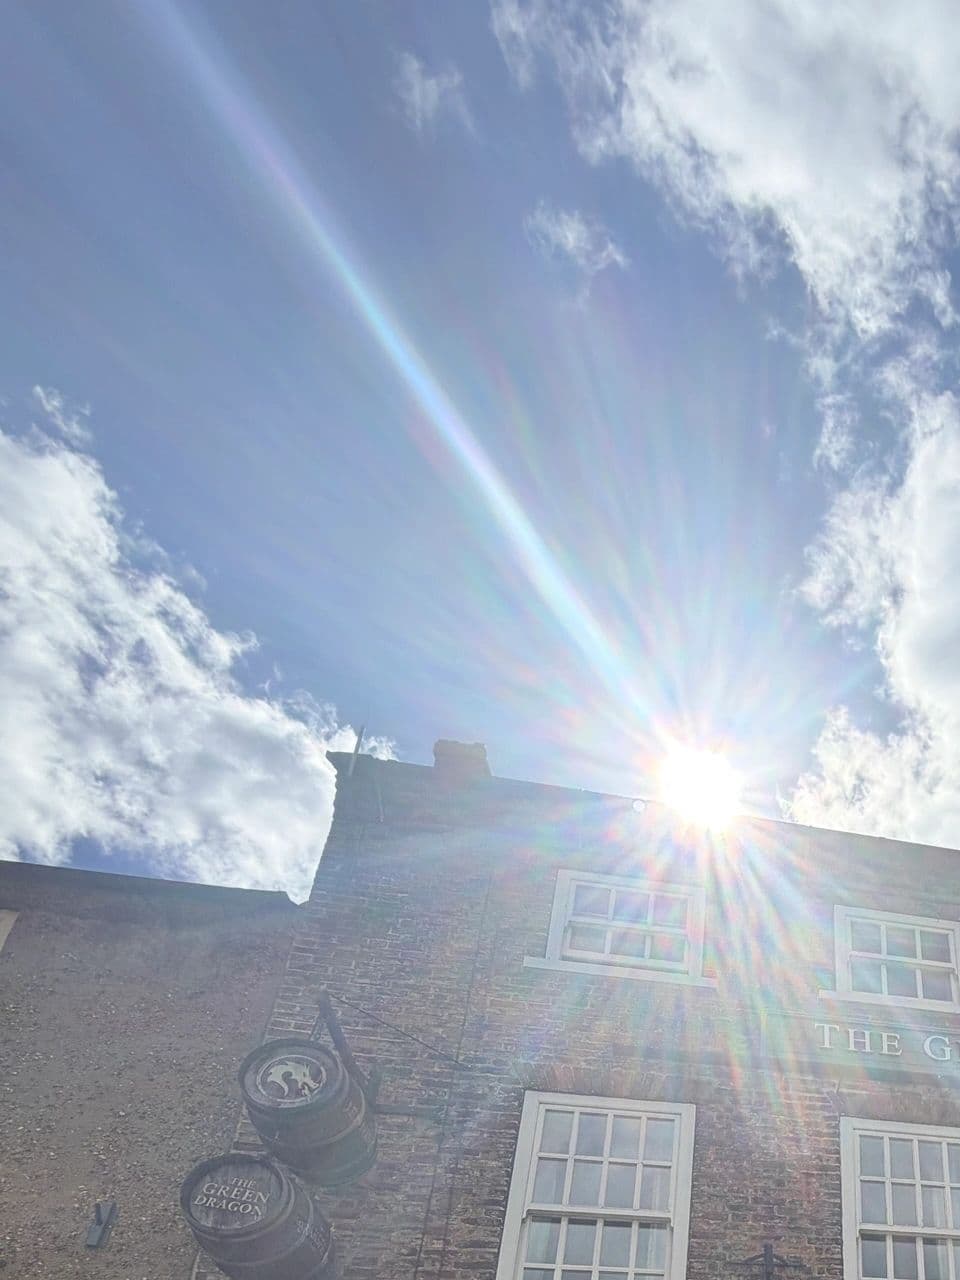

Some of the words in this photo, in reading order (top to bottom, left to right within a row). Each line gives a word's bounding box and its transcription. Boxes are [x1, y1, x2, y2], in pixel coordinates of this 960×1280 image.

[815, 1023, 902, 1056] THE
[202, 1182, 270, 1204] GREEN
[231, 1177, 257, 1189] THE
[193, 1195, 264, 1221] DRAGON
